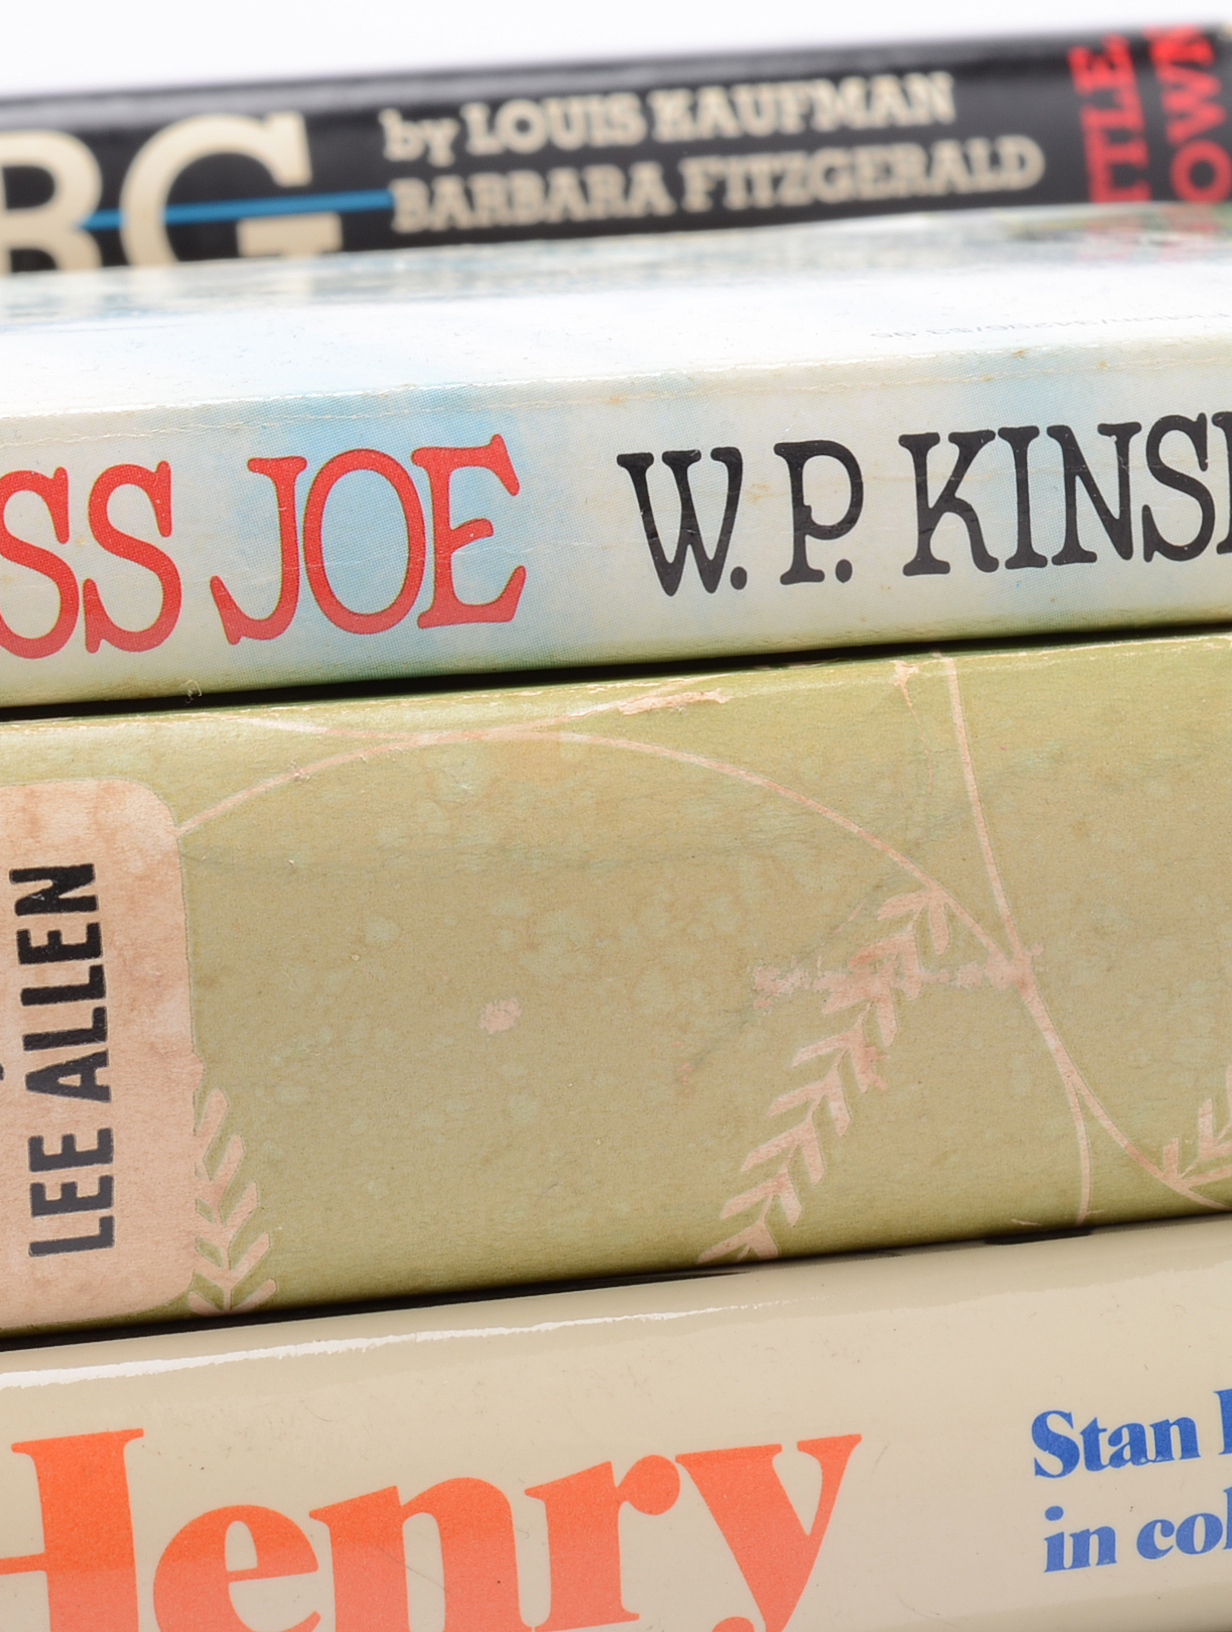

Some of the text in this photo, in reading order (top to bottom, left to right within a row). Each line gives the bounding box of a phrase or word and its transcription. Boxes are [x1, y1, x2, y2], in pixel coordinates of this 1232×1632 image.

[383, 72, 956, 166] by LOUIS KAUFMAN
[388, 136, 1045, 233] BARBARA FITZGERALD
[210, 434, 524, 646] JOE
[9, 862, 116, 1257] LEE ALLEN
[1031, 1409, 1201, 1478] Stan
[1043, 1505, 1118, 1573] in
